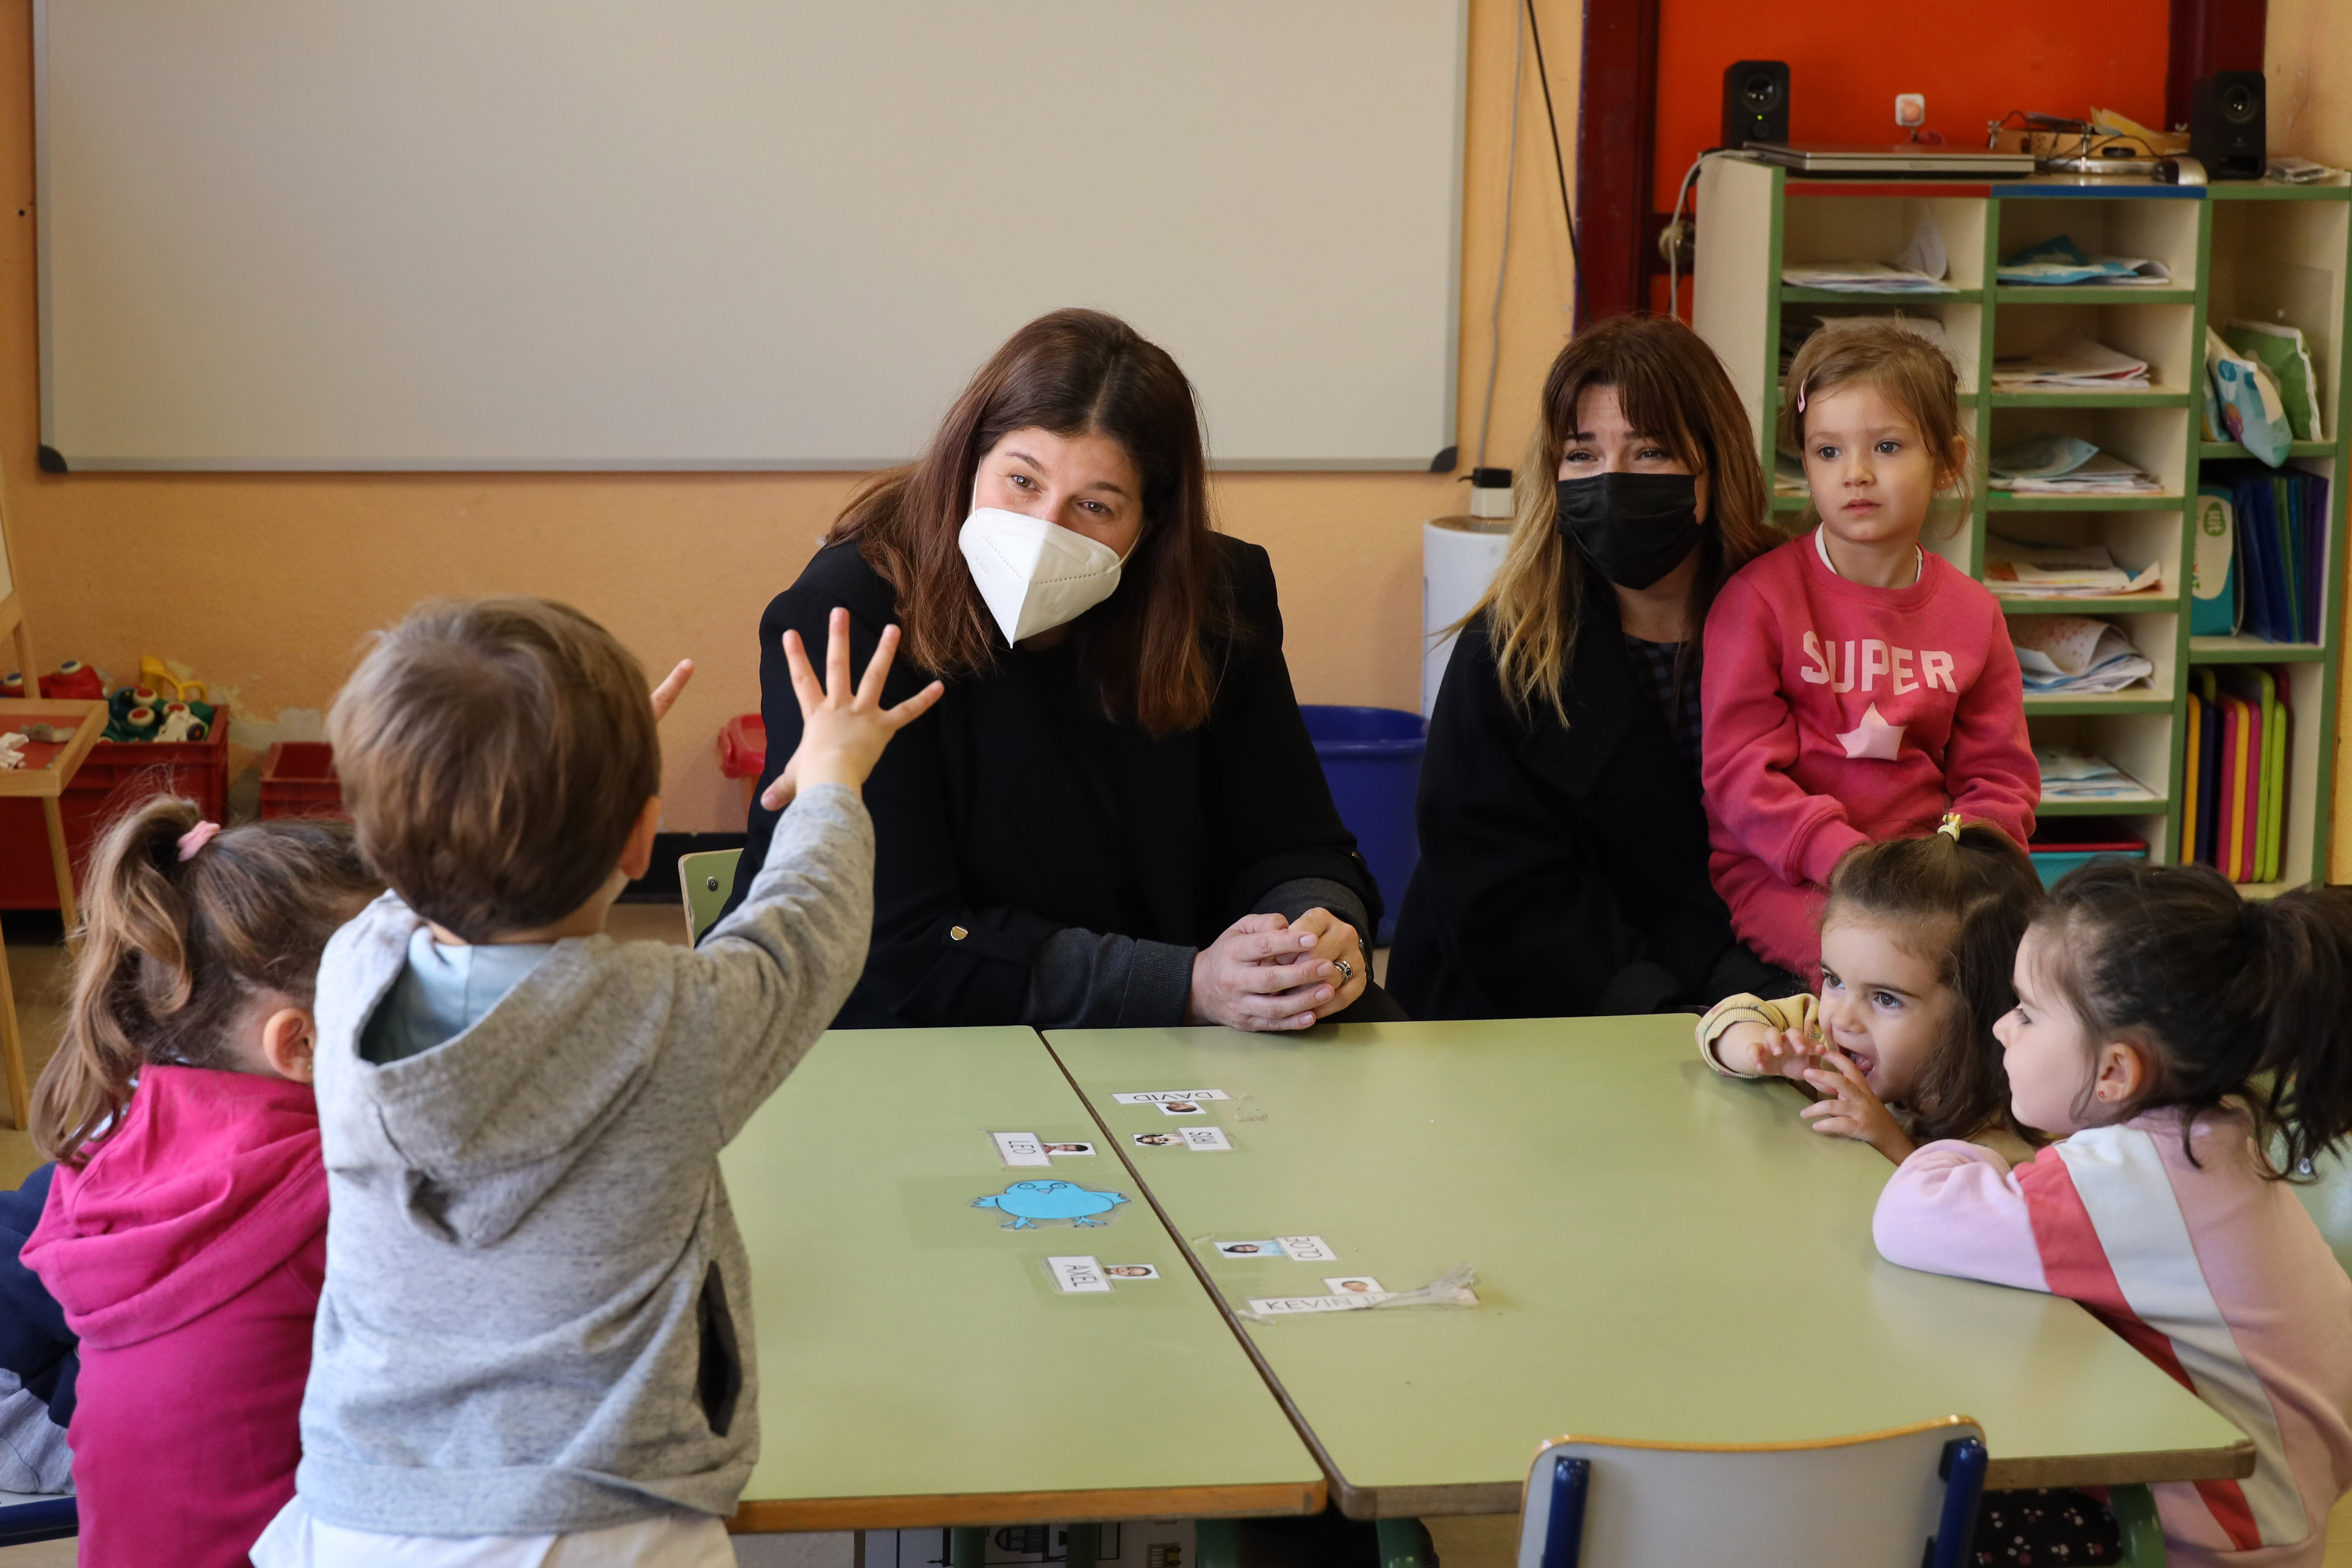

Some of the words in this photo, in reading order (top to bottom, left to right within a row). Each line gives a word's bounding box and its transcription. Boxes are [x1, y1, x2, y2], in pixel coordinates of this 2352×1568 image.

[1801, 630, 1957, 695] SUPER
[1134, 1092, 1214, 1101] DAVID
[1189, 1131, 1218, 1145] IRIS
[1008, 1141, 1036, 1155] LEO
[1063, 1264, 1099, 1287] AXEL
[1266, 1297, 1353, 1310] KEVIN
